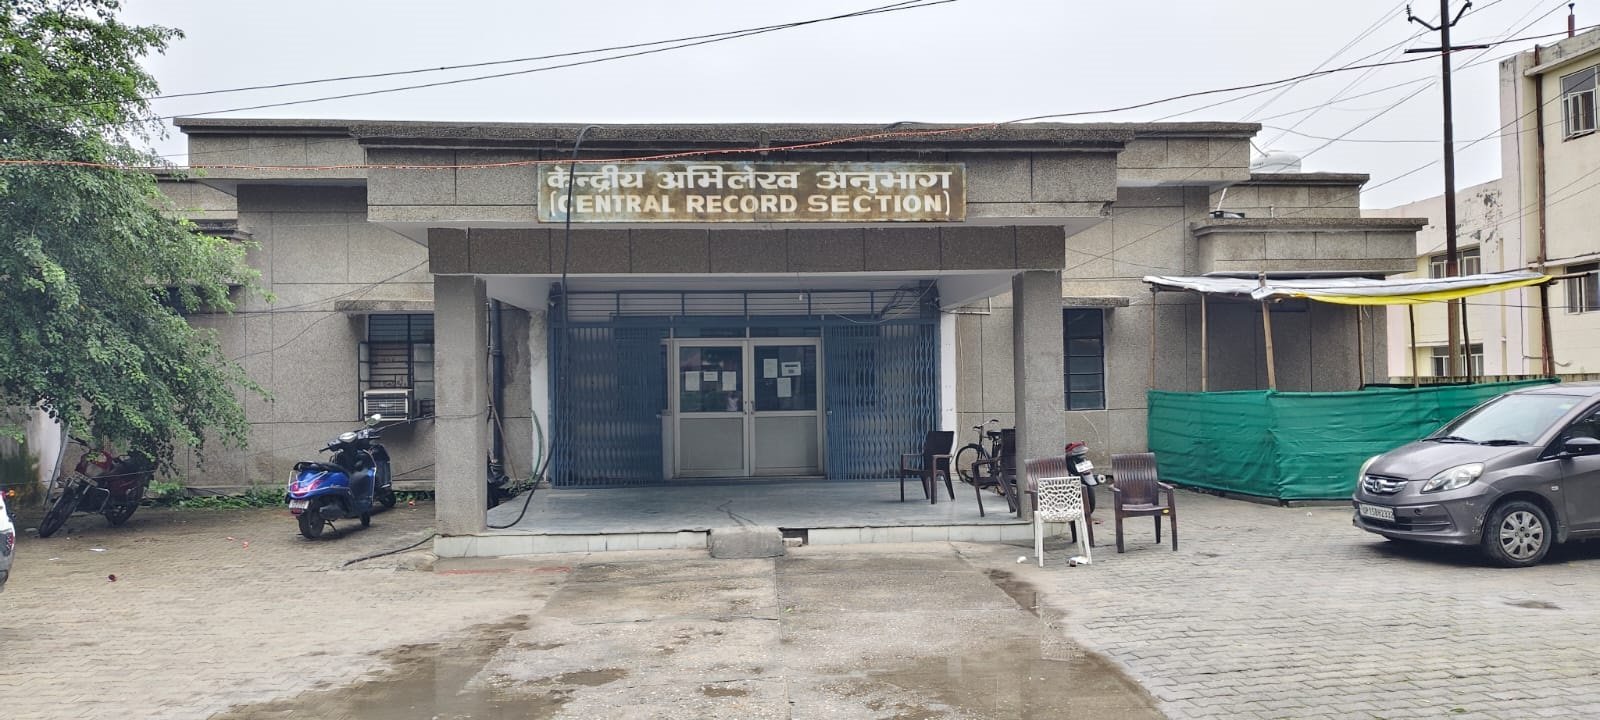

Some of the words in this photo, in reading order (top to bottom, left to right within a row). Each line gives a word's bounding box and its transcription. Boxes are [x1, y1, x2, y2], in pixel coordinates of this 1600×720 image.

[547, 164, 645, 192] केन्द्रीय
[656, 165, 800, 190] अभिलेख
[816, 171, 952, 193] अनुभाग
[550, 191, 675, 216] (CENTRAL
[686, 194, 798, 213] RECORD
[807, 190, 950, 216] SECTION)
